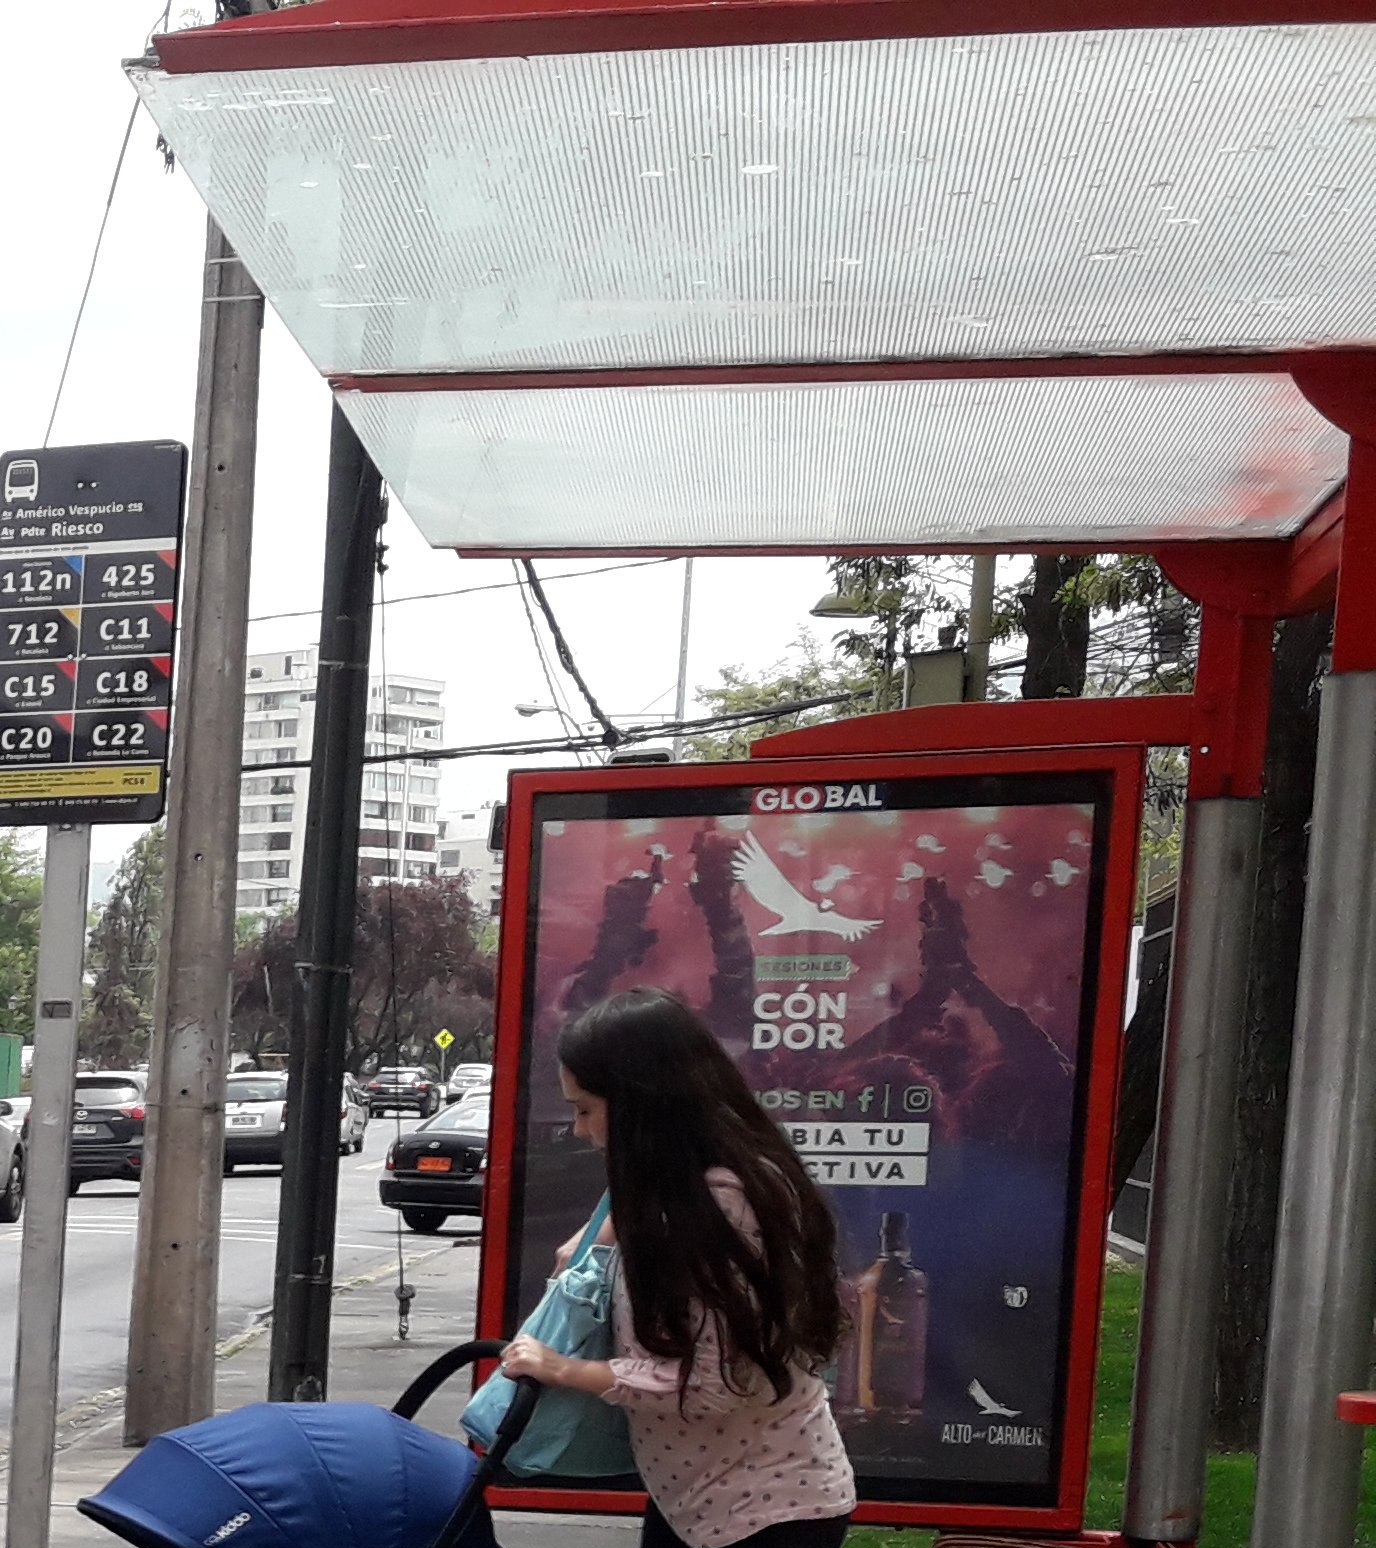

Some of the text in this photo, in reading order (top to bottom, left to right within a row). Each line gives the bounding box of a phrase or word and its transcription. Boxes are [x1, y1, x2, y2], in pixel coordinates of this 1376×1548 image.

[15, 505, 65, 519] Américo
[68, 501, 124, 518] Vespucio
[51, 521, 104, 537] Riesco
[1, 569, 72, 593] 112n
[102, 563, 155, 587] 425
[7, 621, 59, 646] 712
[99, 617, 152, 641] C11
[4, 674, 56, 698] C15
[96, 670, 149, 694] C18
[1, 727, 53, 750] C20
[92, 723, 145, 746] C22
[755, 784, 883, 811] GLOBAL
[753, 983, 848, 1020] CÓN
[752, 1022, 846, 1050] DOR
[807, 1089, 845, 1110] EN
[791, 1128, 905, 1146] BIA TU
[806, 1161, 905, 1180] CTIVA
[941, 1424, 972, 1444] ALTO
[988, 1426, 1045, 1446] CARMEN
